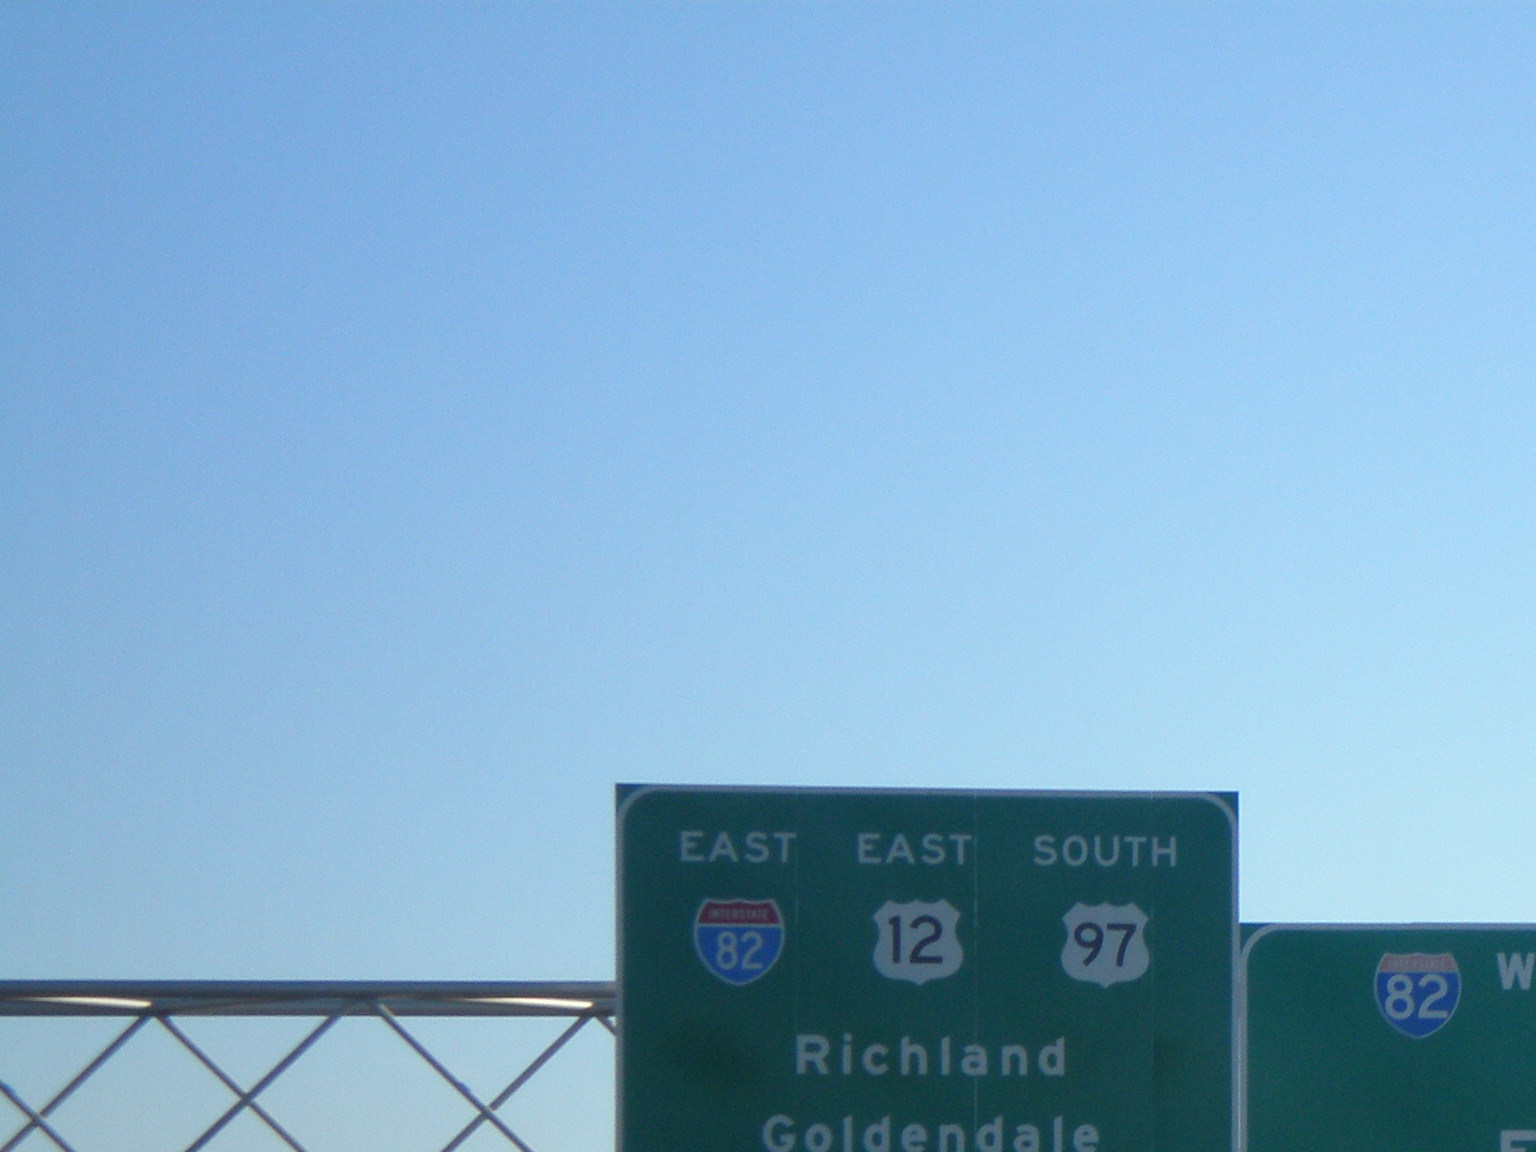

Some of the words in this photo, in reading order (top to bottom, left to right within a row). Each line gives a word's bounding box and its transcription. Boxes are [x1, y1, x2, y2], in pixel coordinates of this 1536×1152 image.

[680, 832, 797, 863] EAST
[857, 834, 972, 865] EAST
[1033, 836, 1177, 867] SOUTH
[717, 932, 763, 969] 82
[887, 915, 943, 964] 12
[1074, 923, 1136, 967] 97
[1385, 974, 1449, 1019] 82
[796, 1034, 1066, 1075] Richland
